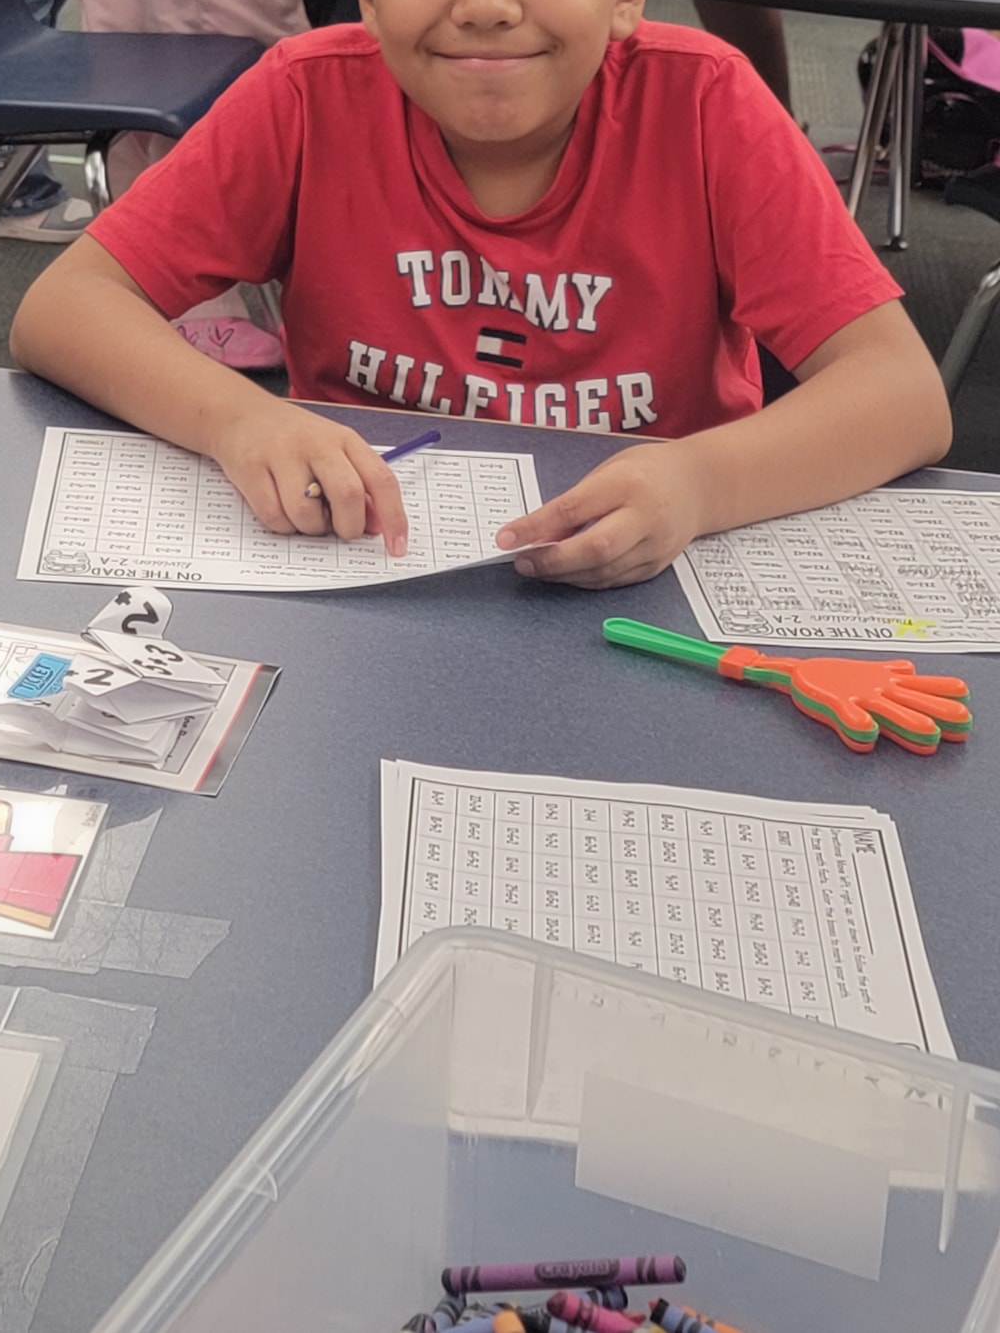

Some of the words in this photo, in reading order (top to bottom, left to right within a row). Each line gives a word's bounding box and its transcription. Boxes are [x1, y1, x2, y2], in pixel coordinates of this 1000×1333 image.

[396, 249, 613, 333] TOMMY
[345, 339, 659, 434] HILFIGER
[99, 555, 128, 567] 2-A
[91, 567, 136, 579] ROAD
[139, 570, 172, 580] THE
[177, 572, 203, 582] ON
[772, 614, 802, 624] 2-A
[810, 615, 914, 627] Multiplication
[775, 626, 824, 638] ROAD
[830, 627, 863, 638] THE
[864, 627, 893, 639] ON
[132, 643, 184, 676] 5+3
[21, 663, 52, 690] TICKET
[777, 830, 791, 846] START
[853, 831, 876, 854] NAME
[815, 852, 825, 866] math
[836, 859, 846, 874] Move
[821, 889, 833, 905] Color
[832, 947, 842, 963] mark
[854, 954, 866, 973] follow
[834, 965, 844, 981] your
[859, 988, 870, 1003] path
[863, 1005, 877, 1015] of
